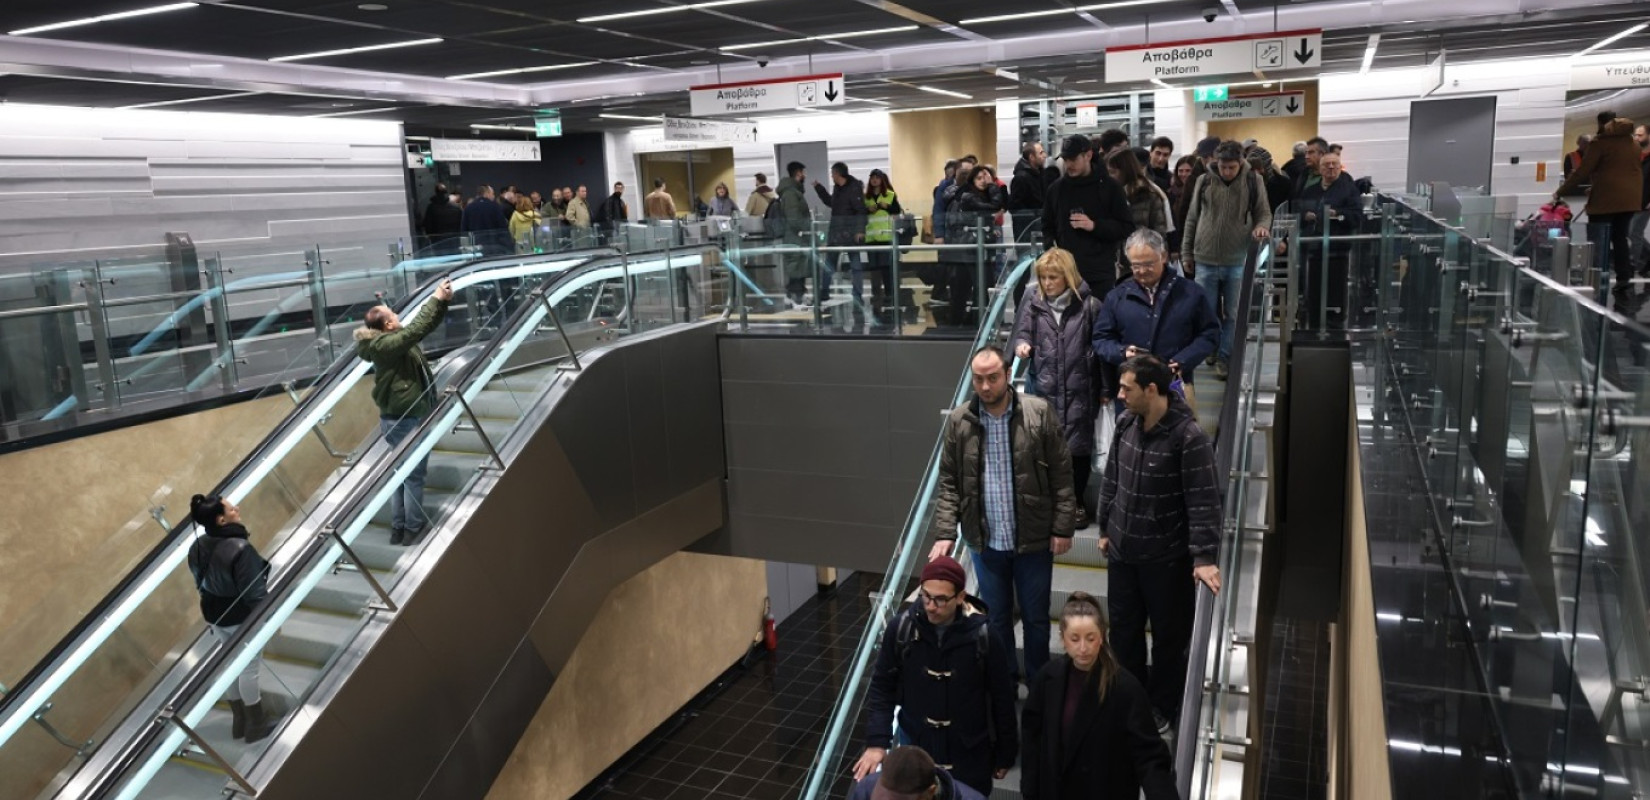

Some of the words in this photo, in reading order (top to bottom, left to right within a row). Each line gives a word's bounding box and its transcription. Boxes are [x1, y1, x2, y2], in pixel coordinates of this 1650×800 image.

[1142, 48, 1213, 63] Αποβάθρα
[1154, 66, 1200, 75] Platform
[717, 88, 767, 101] Αποβάθρα
[726, 102, 758, 110] Platform
